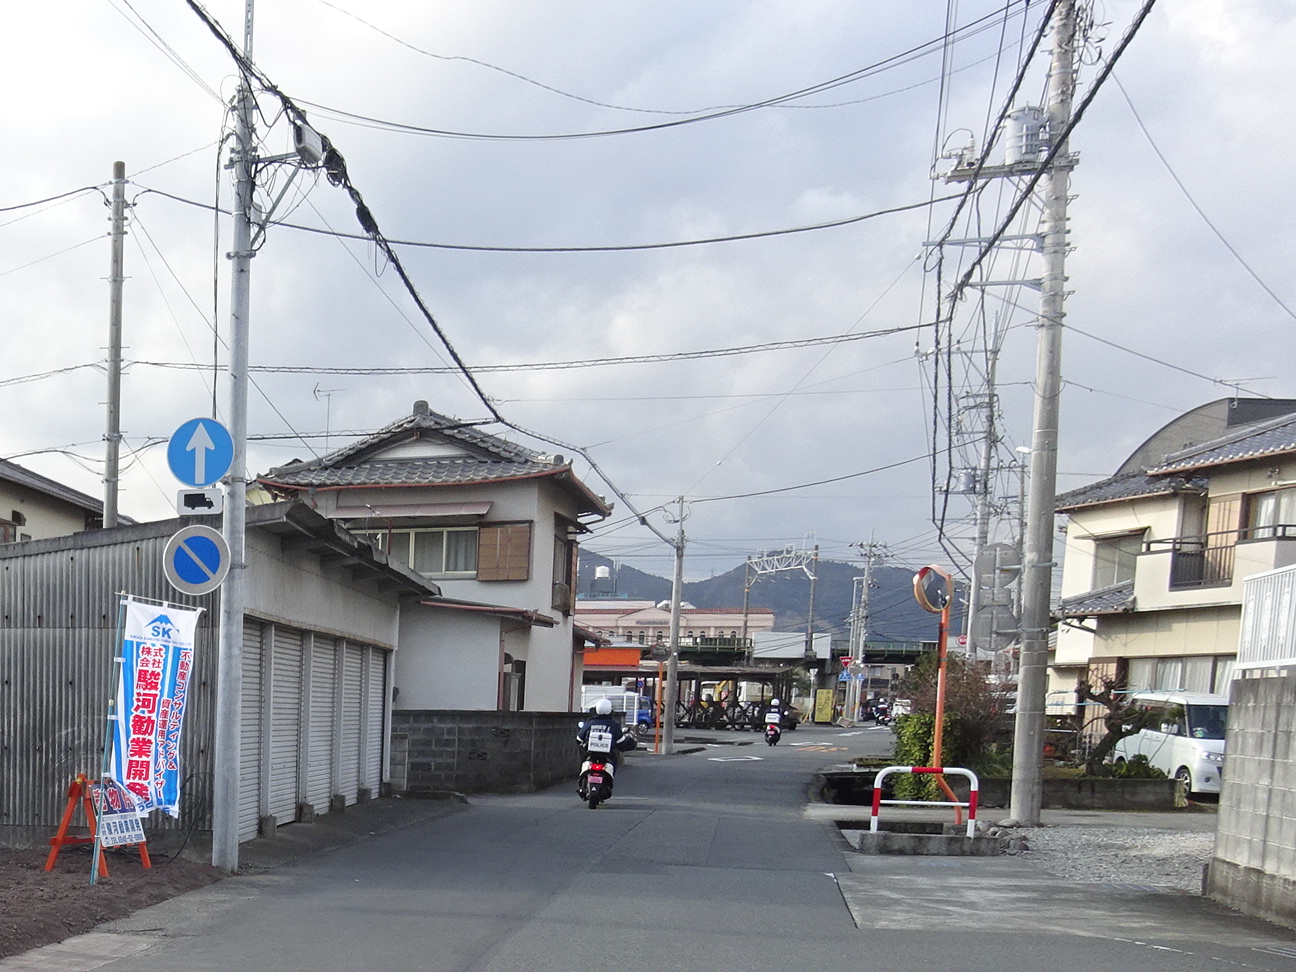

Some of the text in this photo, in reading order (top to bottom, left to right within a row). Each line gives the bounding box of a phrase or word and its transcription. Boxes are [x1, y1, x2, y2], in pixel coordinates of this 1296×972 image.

[151, 625, 172, 639] SK
[141, 646, 164, 658] 株式
[139, 657, 162, 669] 会社
